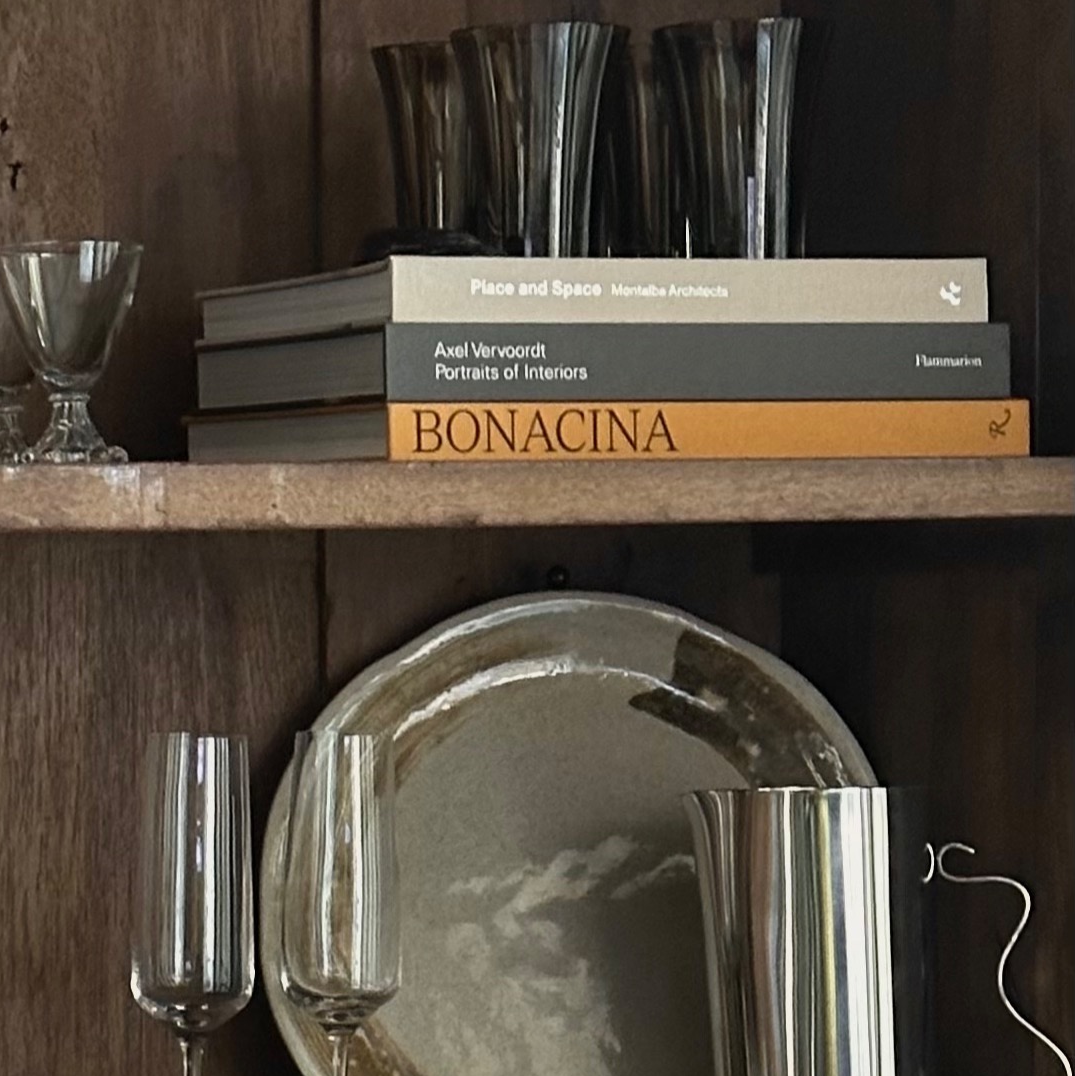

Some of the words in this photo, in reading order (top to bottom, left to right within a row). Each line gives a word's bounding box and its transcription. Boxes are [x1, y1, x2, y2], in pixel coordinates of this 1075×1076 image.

[470, 279, 515, 296] Place
[518, 279, 548, 296] and
[551, 279, 602, 299] Space
[434, 341, 468, 358] Axel
[471, 342, 546, 359] Vervoordt
[435, 363, 499, 380] Portraits
[504, 363, 519, 380] of
[524, 363, 588, 380] Interiors
[412, 408, 679, 453] BONACINA
